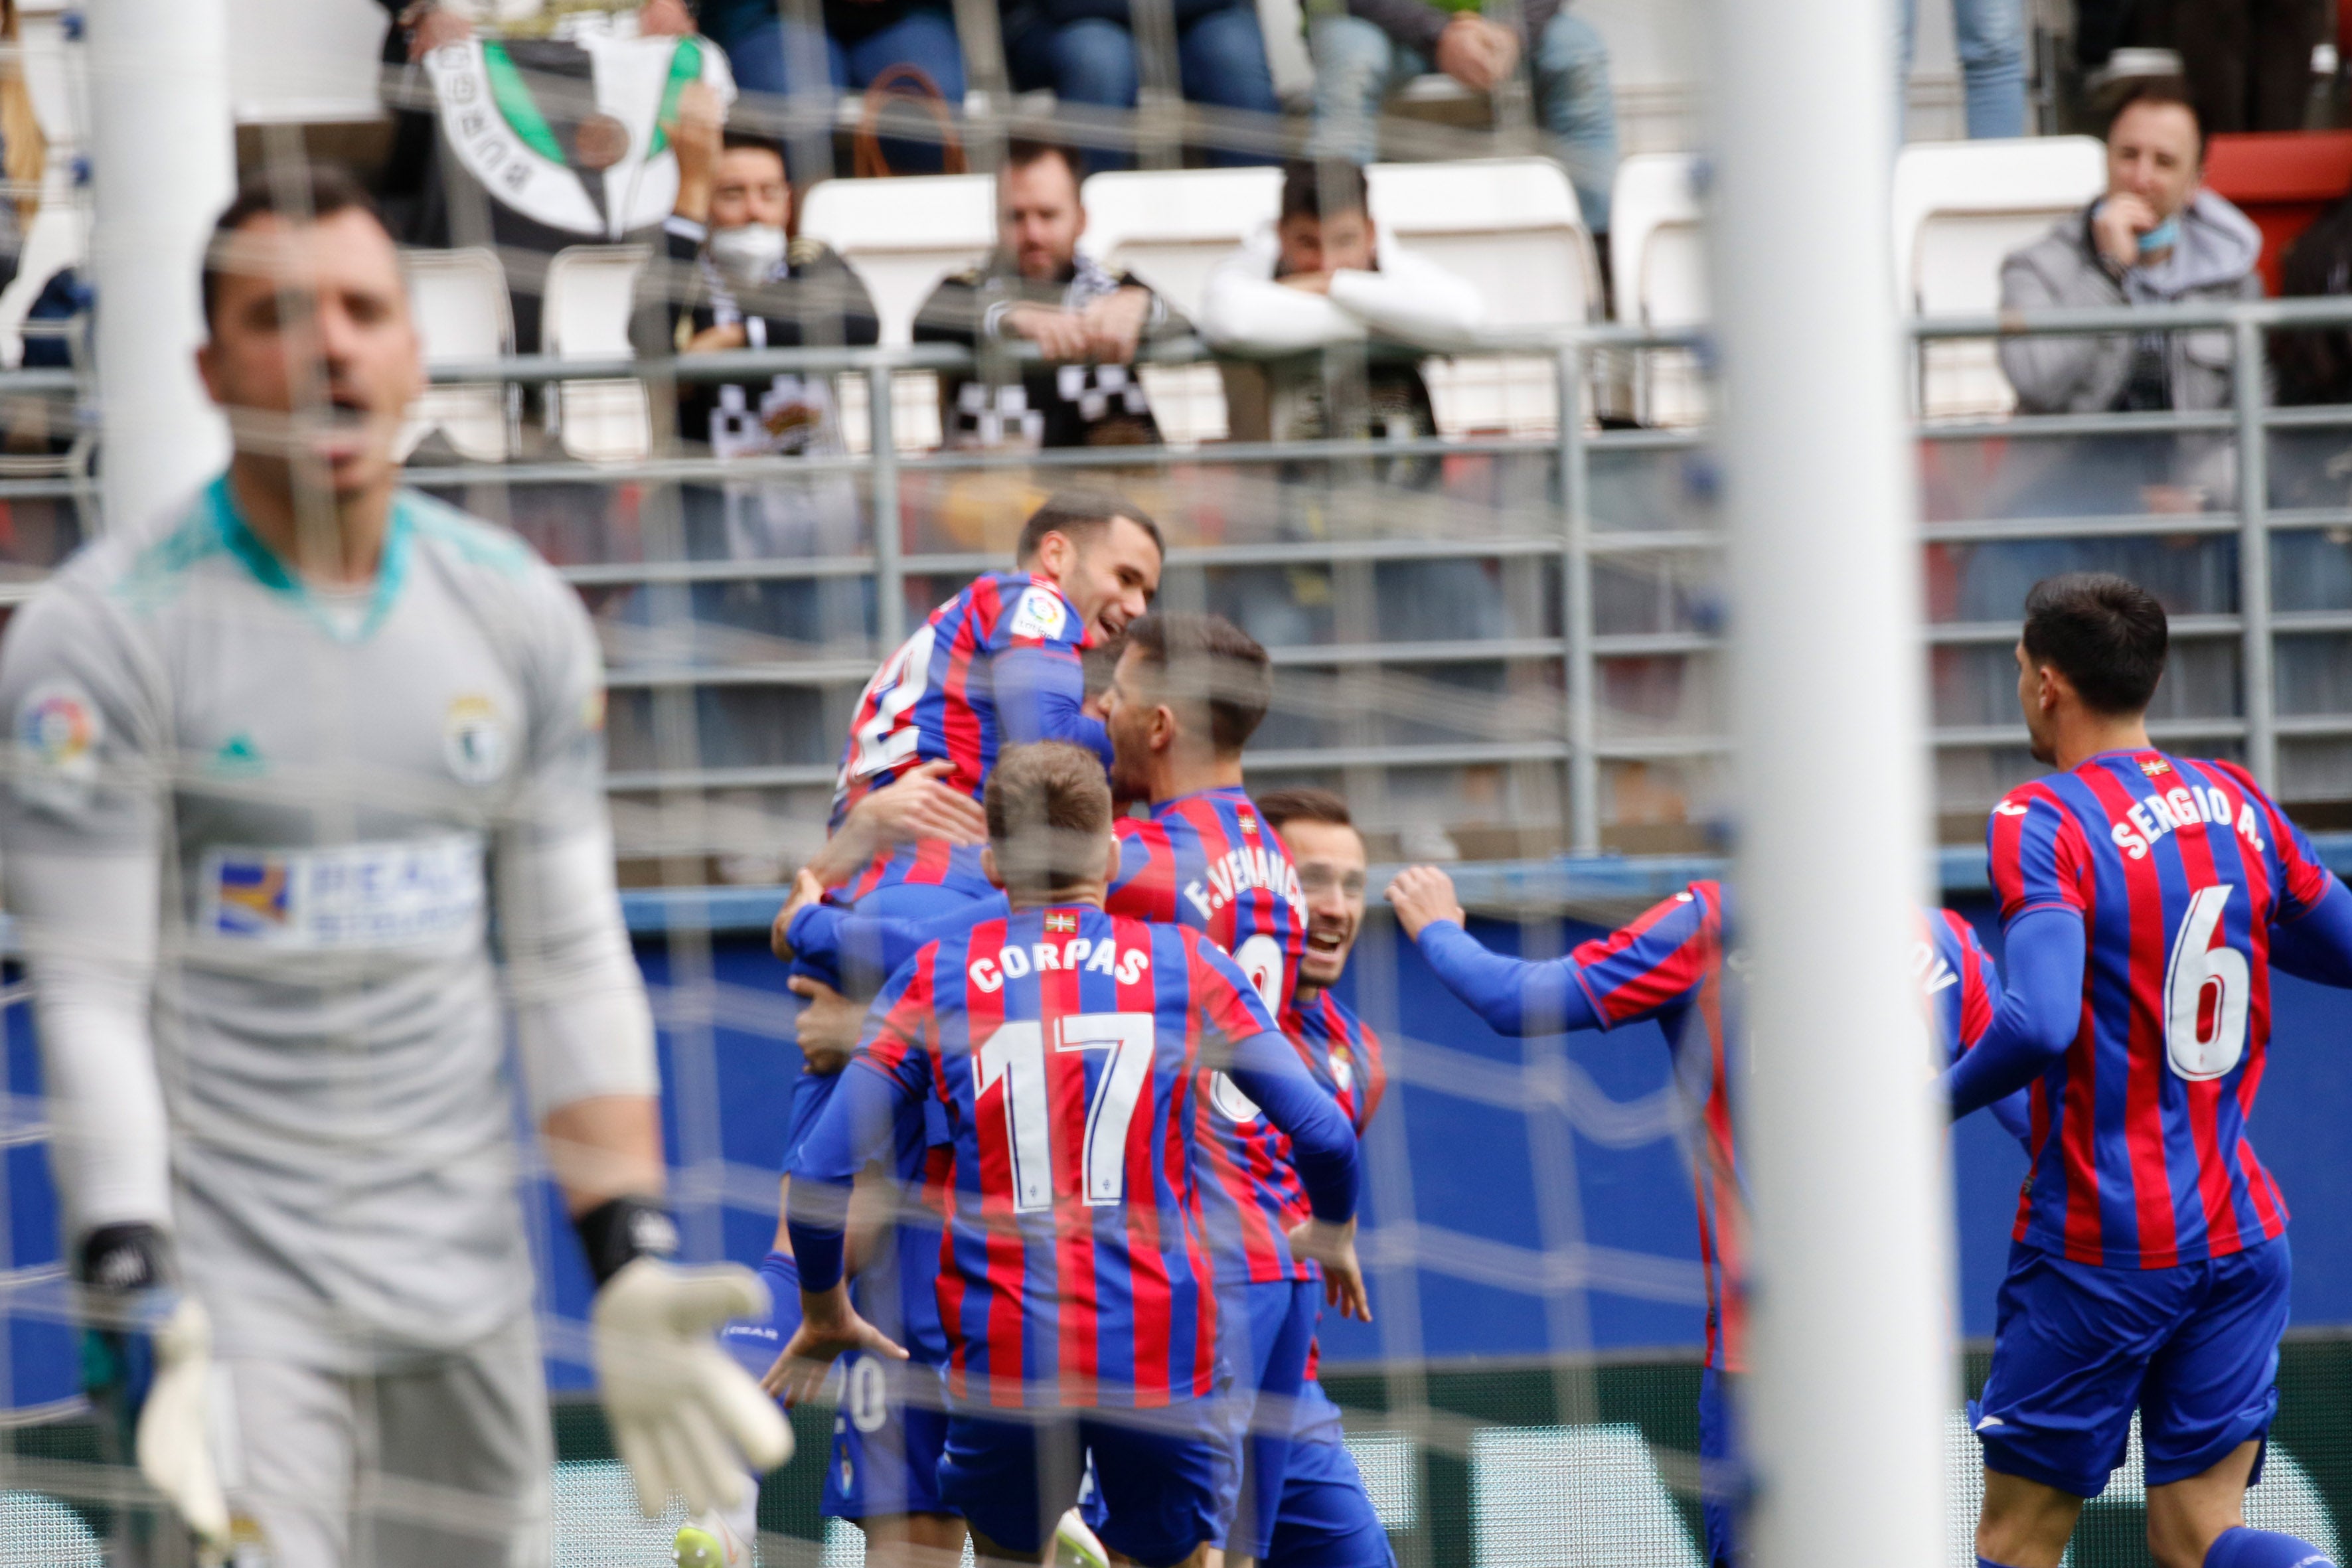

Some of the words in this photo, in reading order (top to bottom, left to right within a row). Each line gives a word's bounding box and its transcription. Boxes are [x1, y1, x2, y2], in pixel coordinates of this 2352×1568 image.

[2112, 785, 2232, 860] SERGIO
[2236, 803, 2265, 852] A.
[969, 937, 1149, 994] CORPAS
[2163, 884, 2250, 1082] 6
[971, 1012, 1155, 1214] 17
